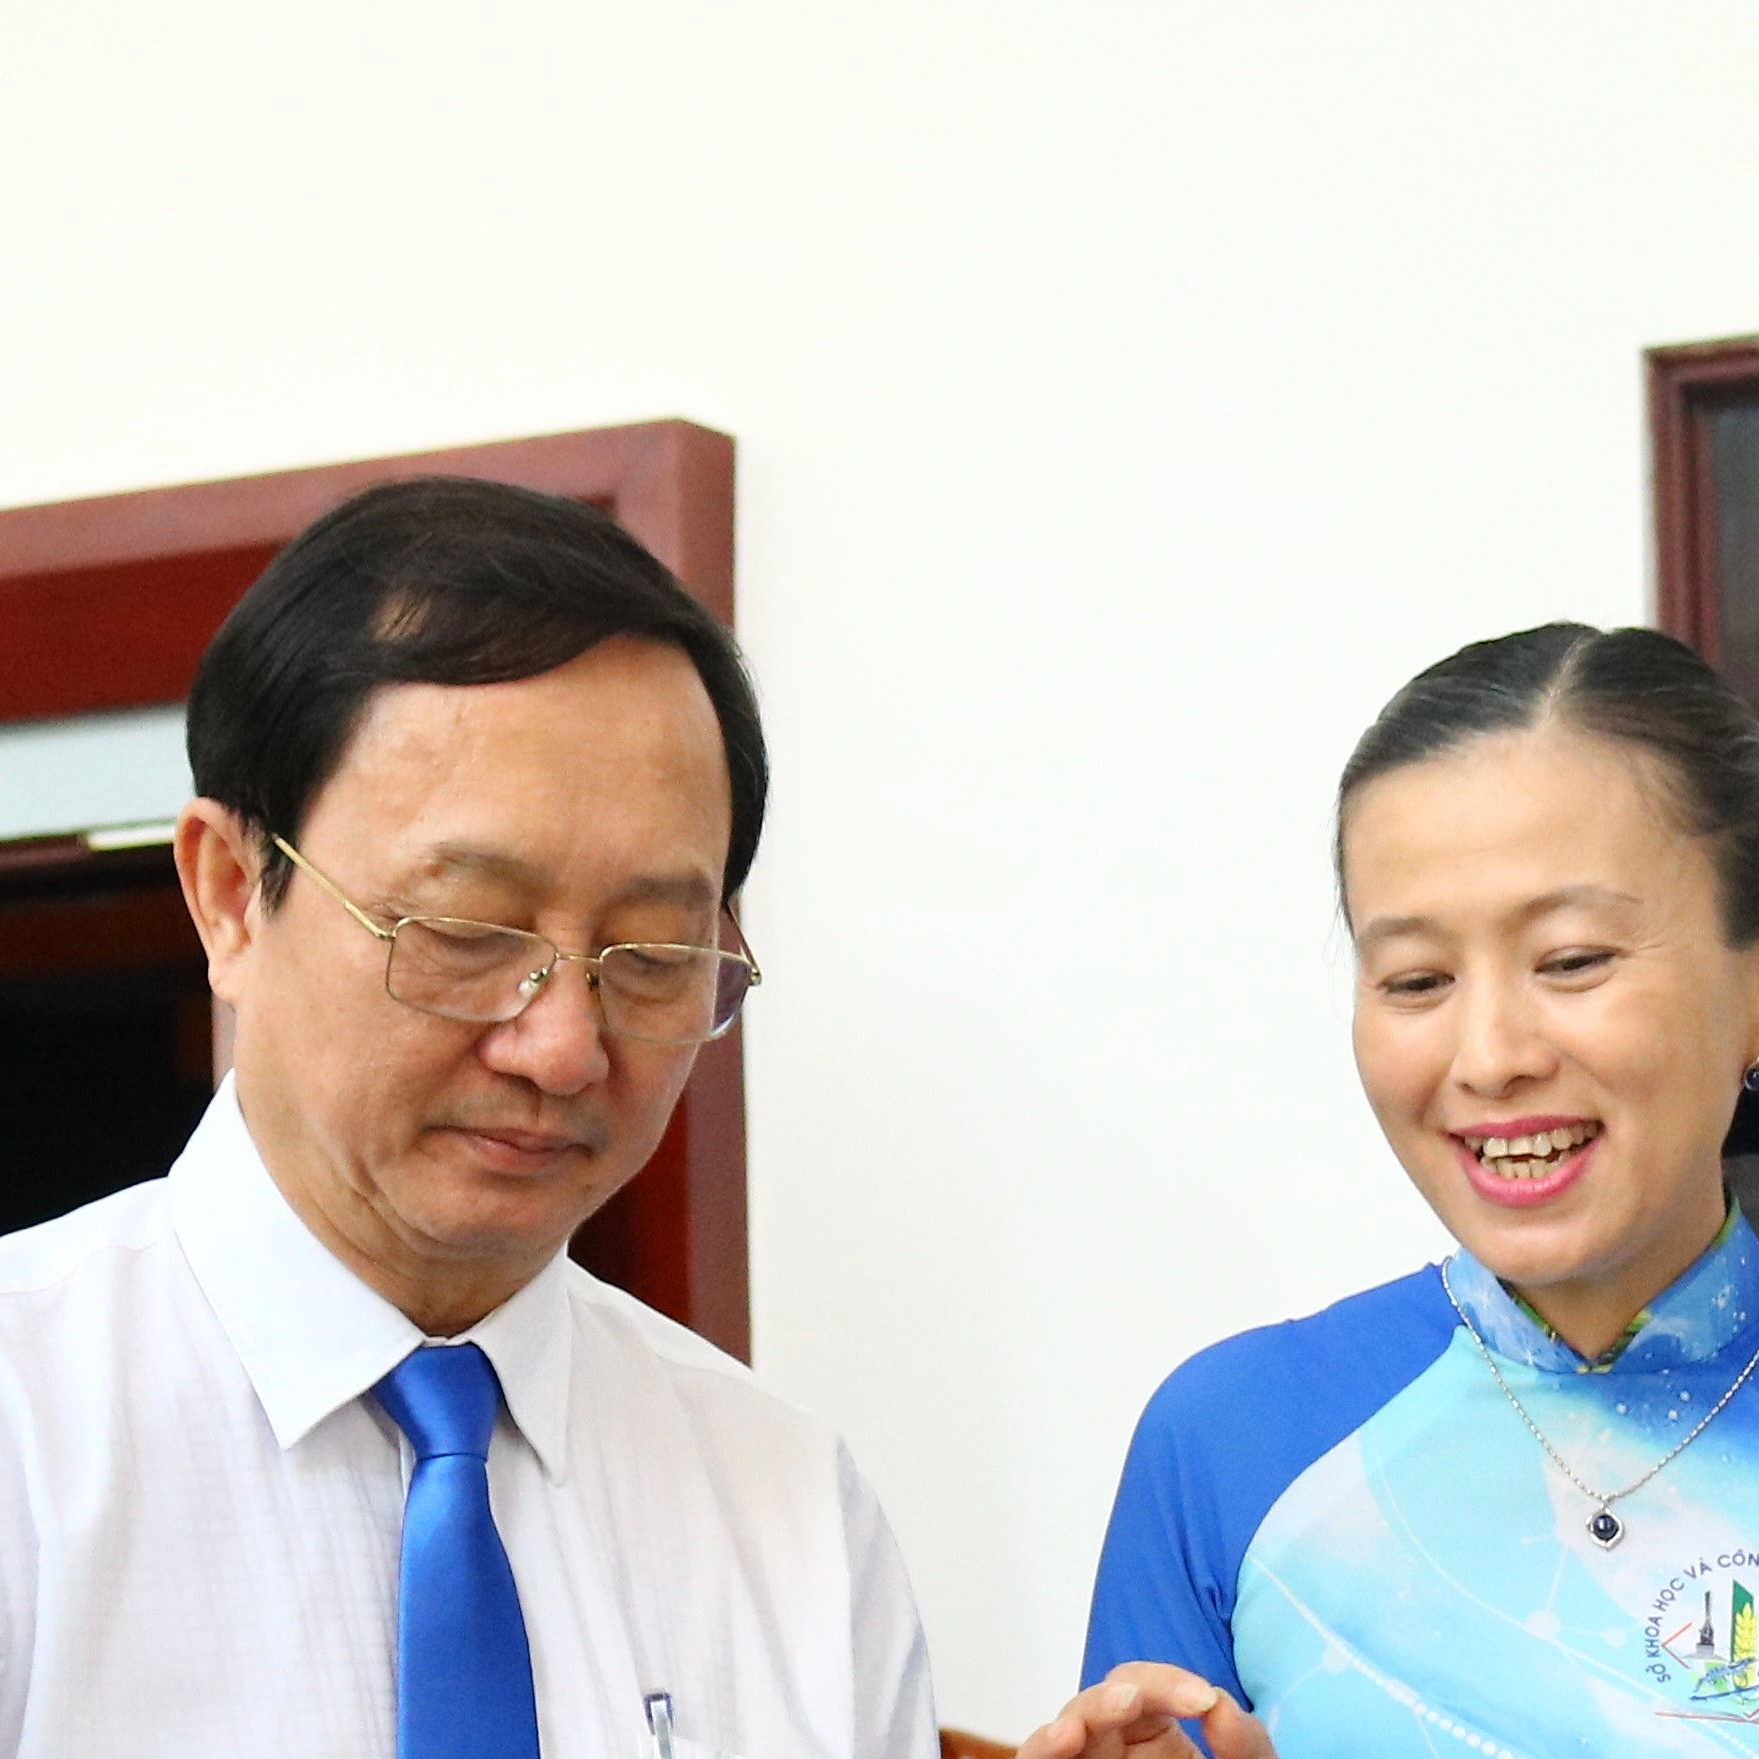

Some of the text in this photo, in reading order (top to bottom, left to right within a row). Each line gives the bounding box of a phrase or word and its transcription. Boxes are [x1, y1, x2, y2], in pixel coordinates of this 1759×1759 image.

[1683, 1557, 1712, 1579] VÀ
[1653, 1578, 1685, 1612] HỌC
[1645, 1615, 1662, 1658] KHOA
